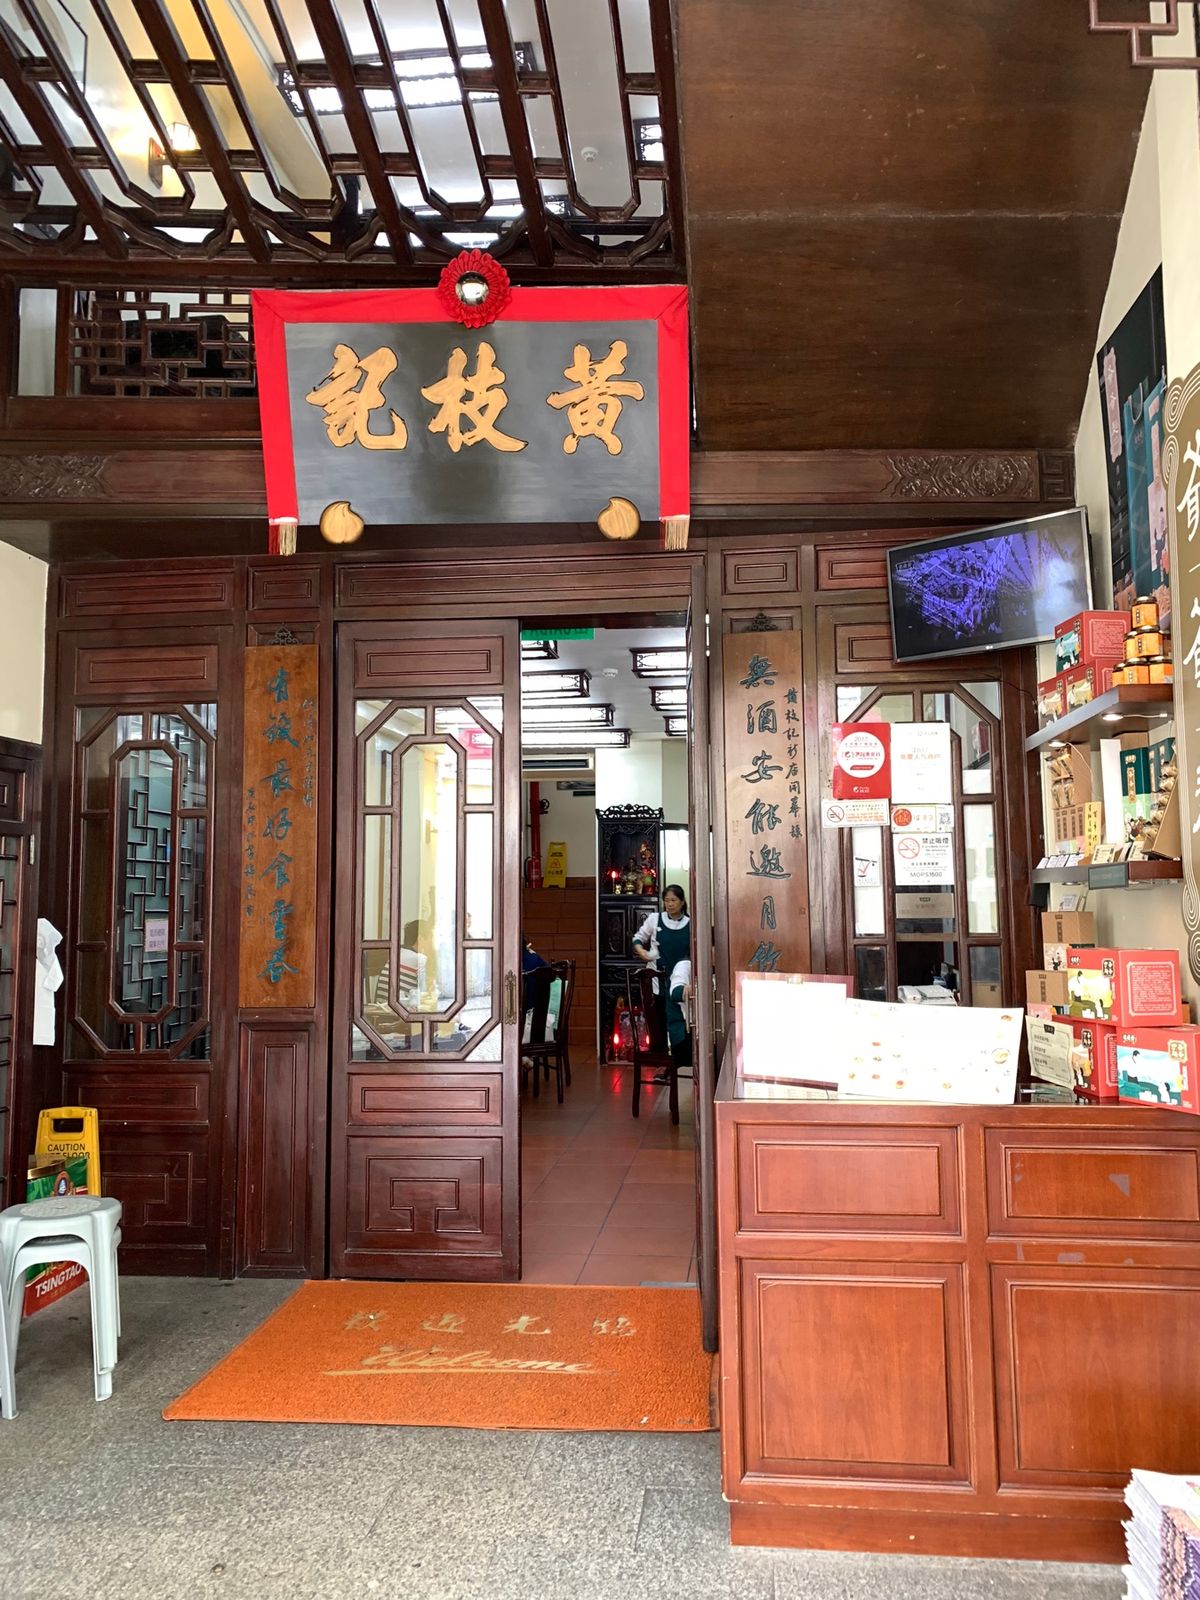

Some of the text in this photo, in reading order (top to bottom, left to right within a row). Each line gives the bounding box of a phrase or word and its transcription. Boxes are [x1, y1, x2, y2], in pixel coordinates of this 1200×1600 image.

[47, 1143, 86, 1152] CAUTION
[35, 1263, 82, 1298] TSINGTAO
[361, 1345, 592, 1372] Welcome
